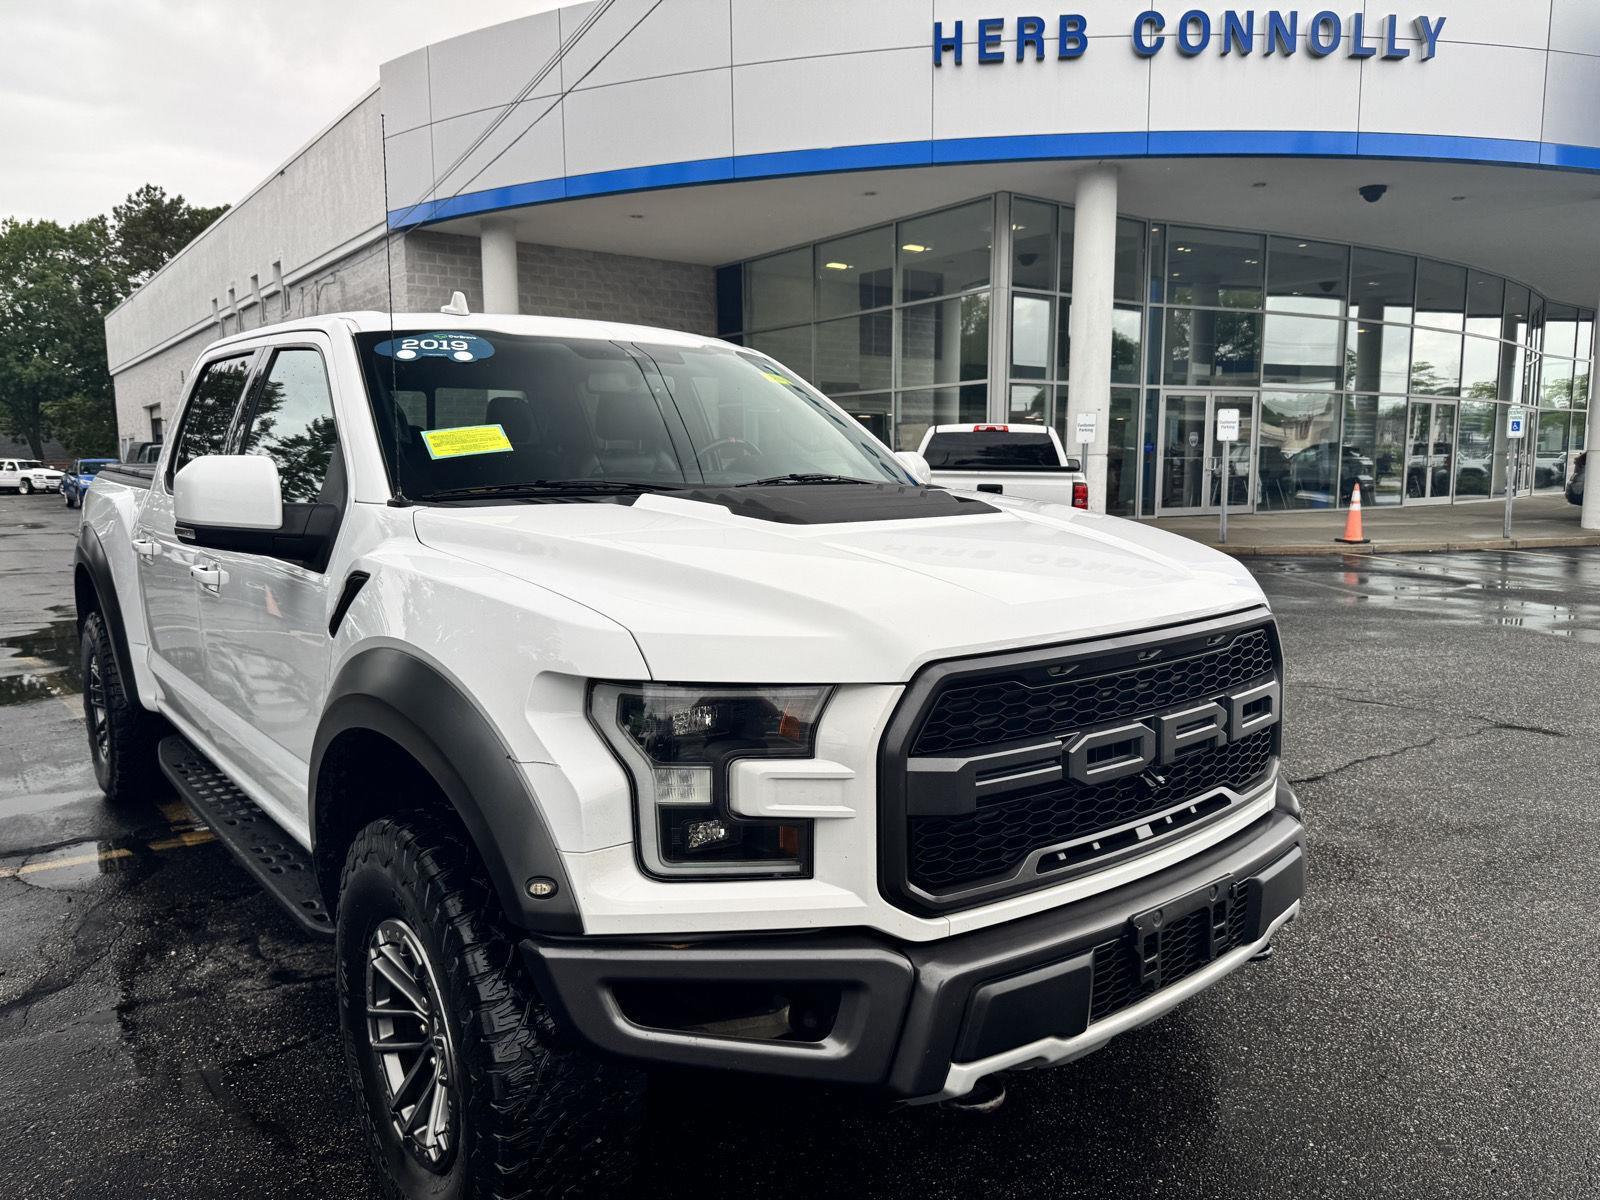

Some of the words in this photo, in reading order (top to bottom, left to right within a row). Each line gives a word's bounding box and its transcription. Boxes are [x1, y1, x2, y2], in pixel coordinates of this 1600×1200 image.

[934, 14, 1089, 66] HERB
[1132, 10, 1446, 62] CONNOLLY
[401, 339, 469, 351] 2019
[945, 680, 1281, 815] FORD
